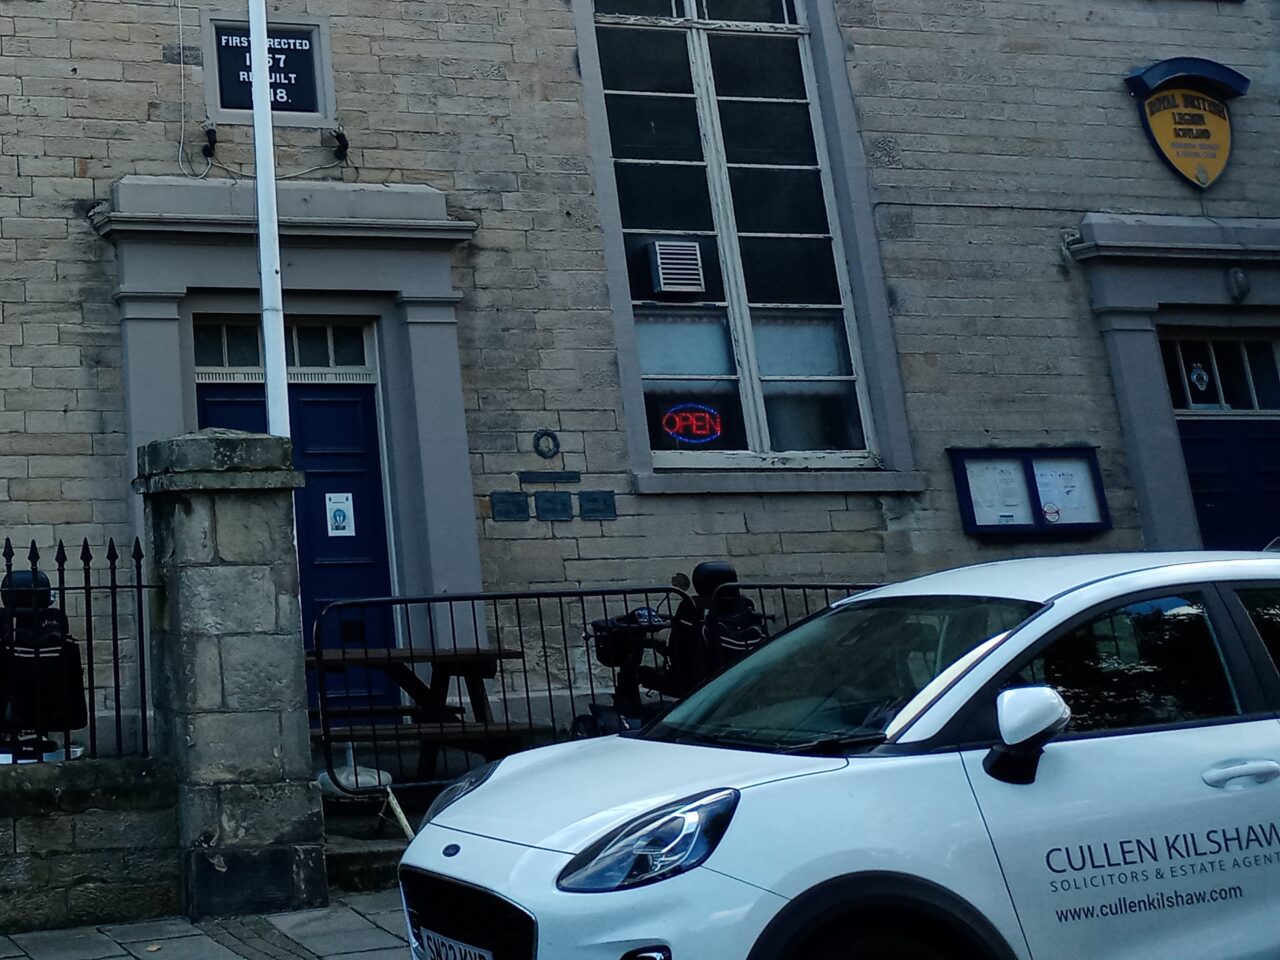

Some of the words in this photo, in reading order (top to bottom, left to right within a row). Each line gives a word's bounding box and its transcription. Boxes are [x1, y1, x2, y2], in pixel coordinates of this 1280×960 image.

[221, 35, 252, 47] FIRS
[267, 38, 310, 50] RECTED
[663, 412, 721, 434] OPEN
[1045, 837, 1159, 874] CULLEN
[1050, 869, 1150, 893] SOLICITORS
[1155, 868, 1166, 880] &
[1171, 860, 1226, 878] ESTATE
[1055, 886, 1243, 923] www.cullenkilshaw.com
